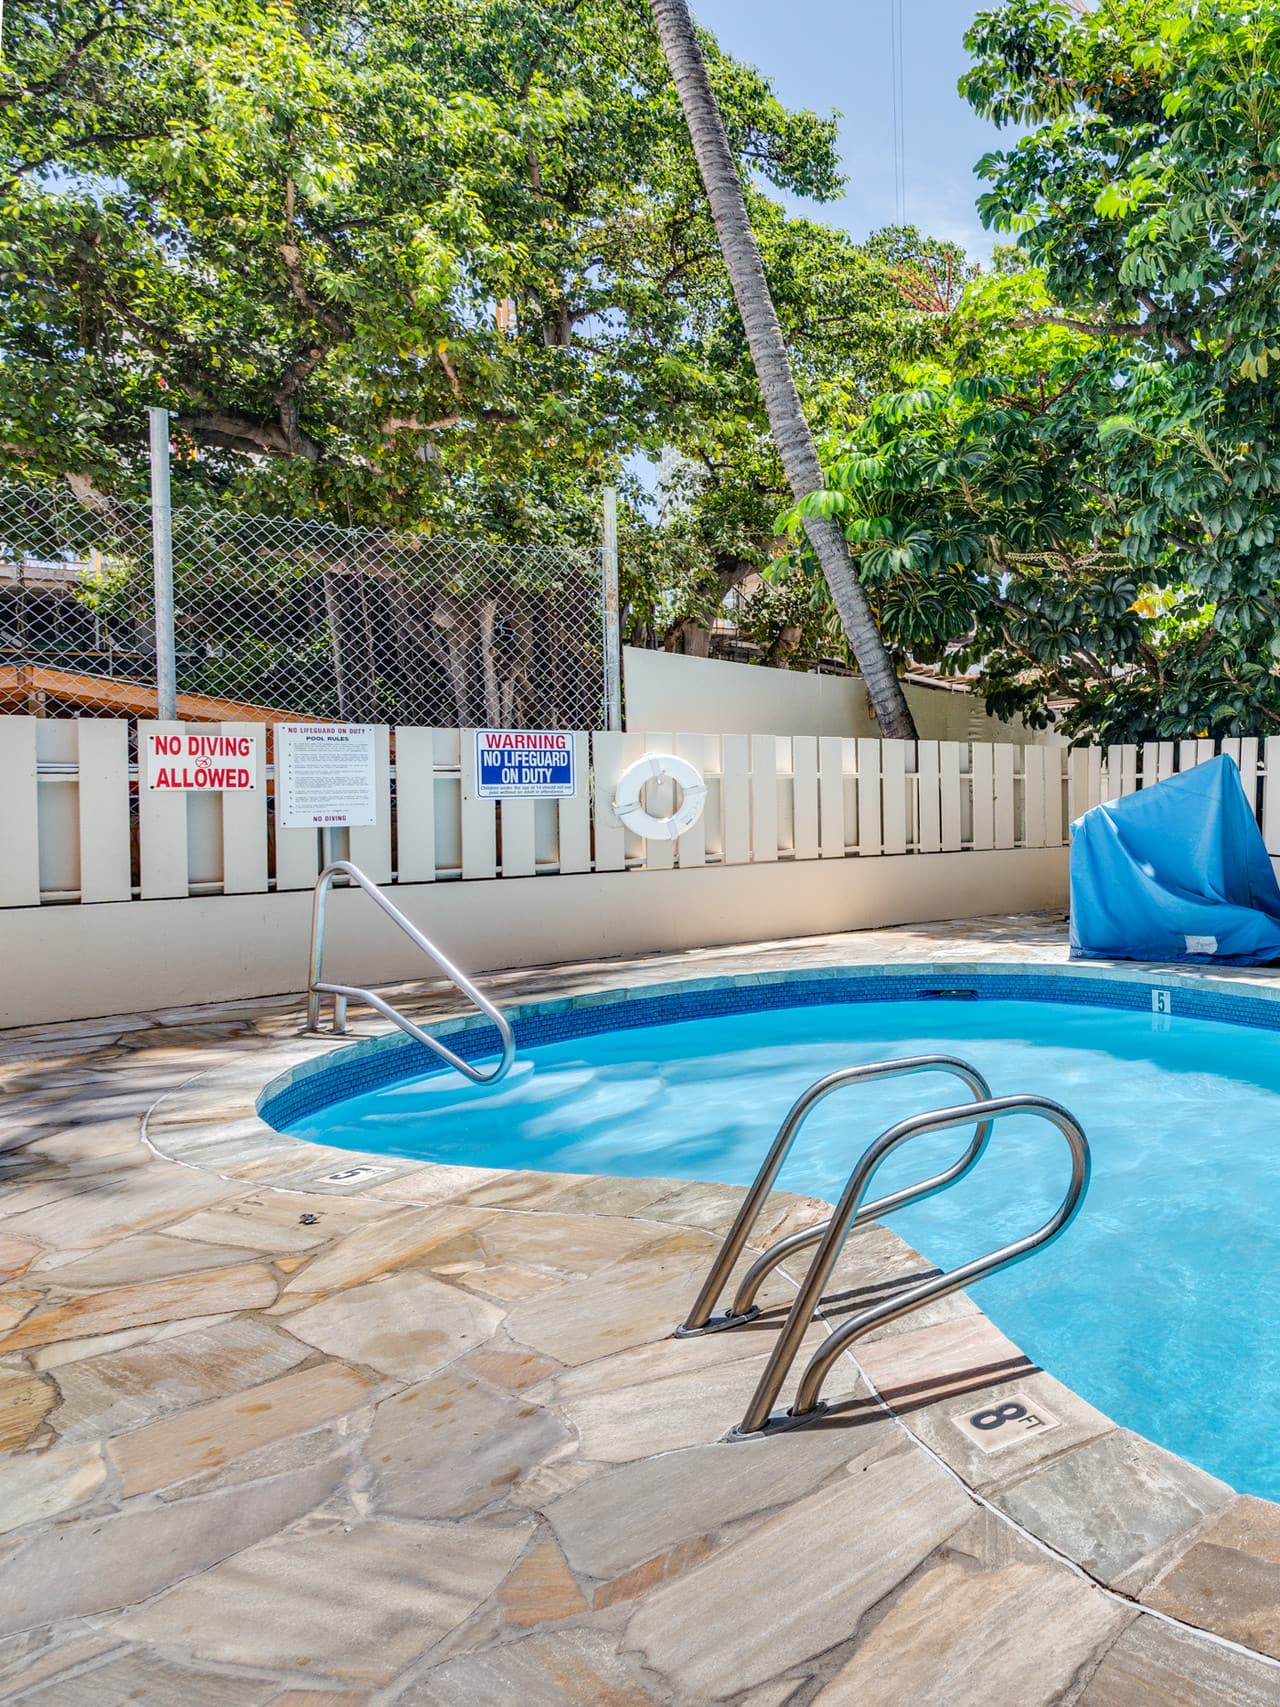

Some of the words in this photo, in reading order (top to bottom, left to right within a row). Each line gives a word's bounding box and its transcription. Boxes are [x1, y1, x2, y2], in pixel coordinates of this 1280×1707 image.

[155, 735, 182, 756] NO
[188, 736, 250, 757] DIVING
[485, 734, 567, 749] WARNING
[483, 751, 501, 767] NO
[504, 751, 568, 767] LIFEGUARD
[156, 768, 250, 788] ALLOWED
[501, 768, 519, 784] ON
[522, 768, 552, 784] DUTY
[1158, 992, 1165, 1011] 5
[970, 1403, 1027, 1430] 8
[1018, 1414, 1046, 1430] FT
